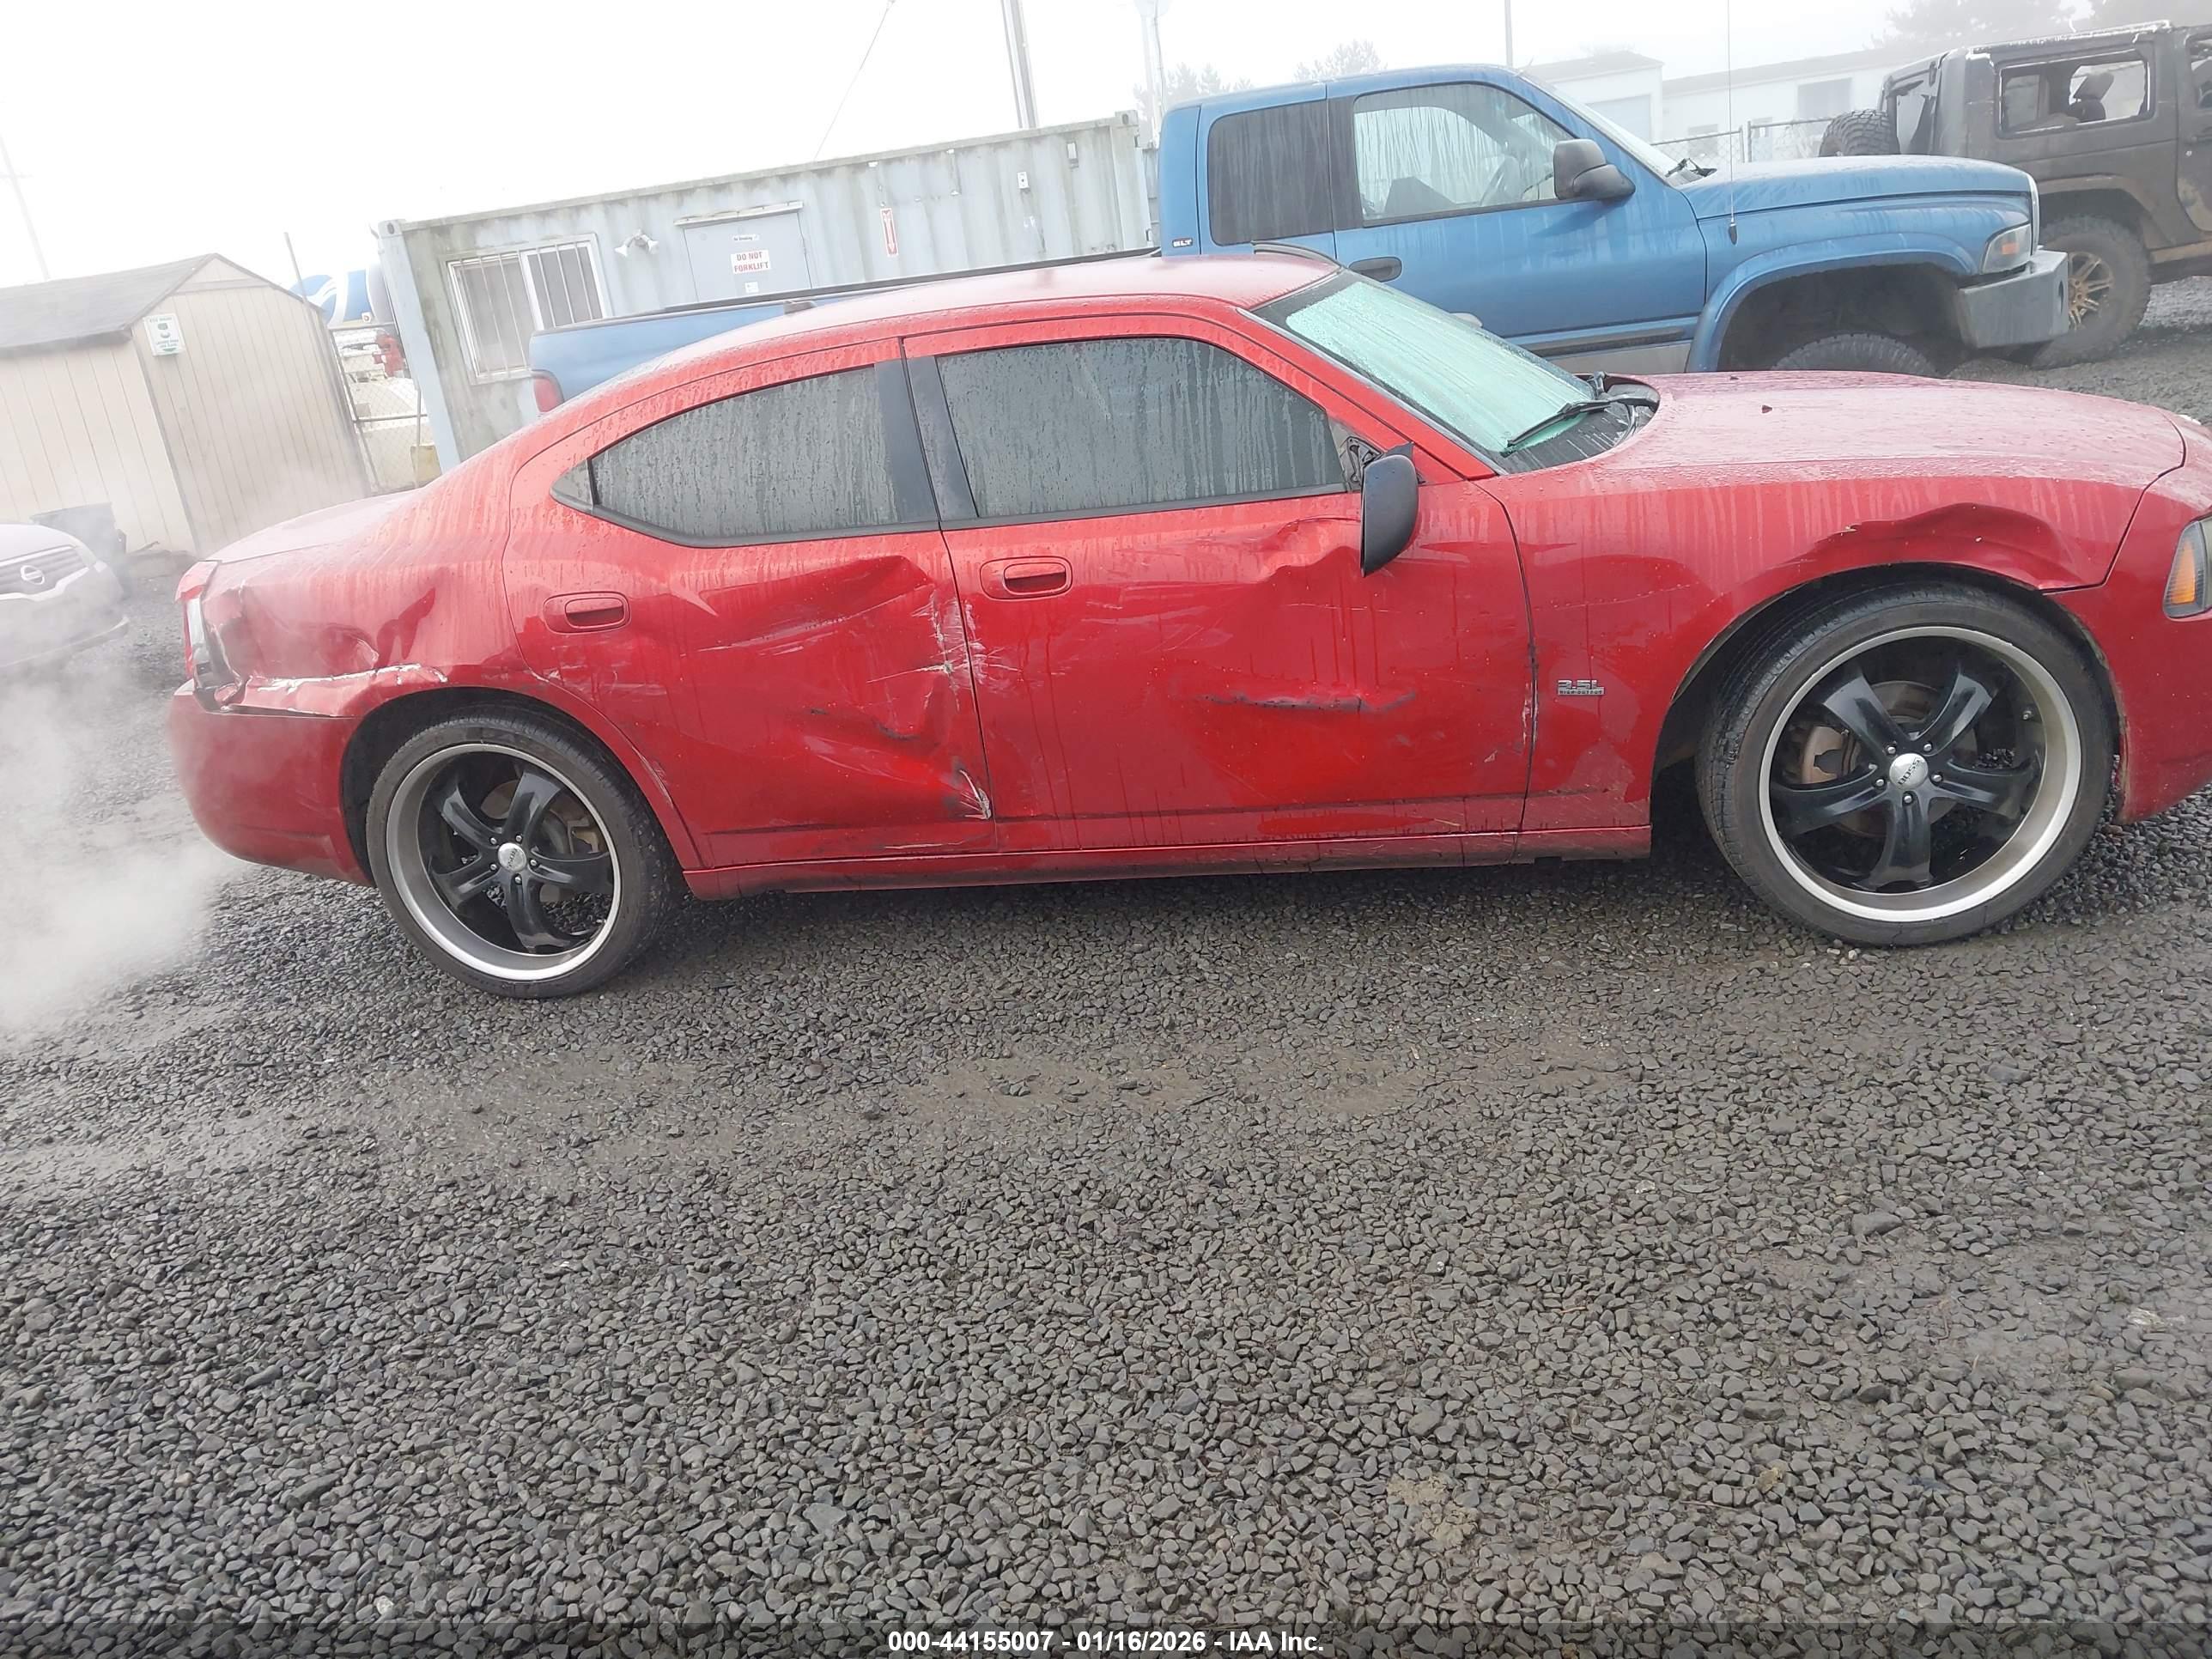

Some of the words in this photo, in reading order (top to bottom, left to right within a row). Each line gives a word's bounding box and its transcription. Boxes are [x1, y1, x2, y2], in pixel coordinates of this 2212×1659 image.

[749, 251, 763, 260] NOT
[734, 261, 769, 272] FORKLIFT
[1558, 679, 1604, 690] 3.5L
